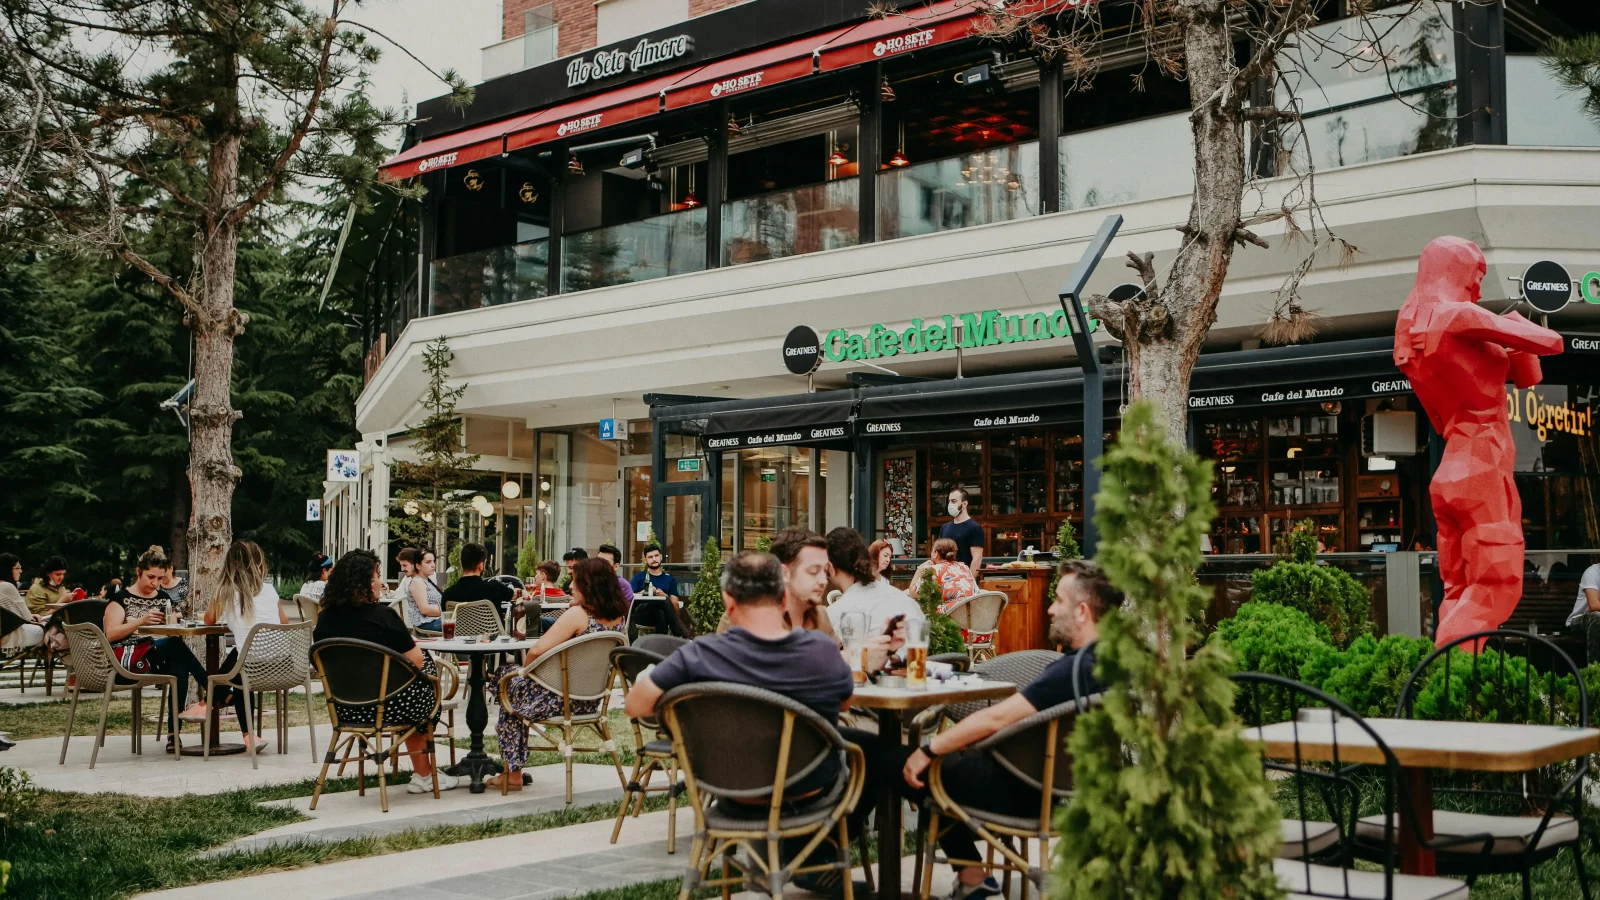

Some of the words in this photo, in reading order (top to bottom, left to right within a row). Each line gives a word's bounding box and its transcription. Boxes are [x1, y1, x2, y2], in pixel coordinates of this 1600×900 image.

[886, 37, 904, 50] HO
[905, 30, 933, 45] SETE
[566, 57, 591, 88] Ho
[592, 48, 626, 80] Sete
[630, 34, 690, 72] Amore
[722, 79, 737, 91] HO
[738, 72, 762, 87] SETE
[566, 120, 580, 131] HO
[580, 115, 601, 127] SETE
[427, 157, 438, 167] HO
[438, 153, 457, 164] SETE
[1526, 281, 1569, 292] GREATNESS
[825, 324, 899, 362] Cafe
[902, 315, 957, 354] del
[1571, 338, 1600, 350] GREAT
[785, 345, 817, 357] GREATNESS
[1188, 395, 1234, 407] GREATNESS
[1261, 391, 1284, 402] Cafe
[1286, 390, 1302, 400] del
[1305, 386, 1344, 398] Mundo
[1372, 379, 1412, 392] GREATNE
[1505, 387, 1521, 423] ol
[866, 422, 901, 433] GREATNESS
[974, 418, 992, 427] Cafe
[994, 416, 1007, 425] del
[1008, 414, 1040, 424] Mundo
[708, 437, 739, 448] GREATNESS
[747, 435, 762, 444] Cafe
[764, 433, 775, 443] del
[776, 431, 801, 442] Mundo
[810, 426, 844, 439] GREATNESS
